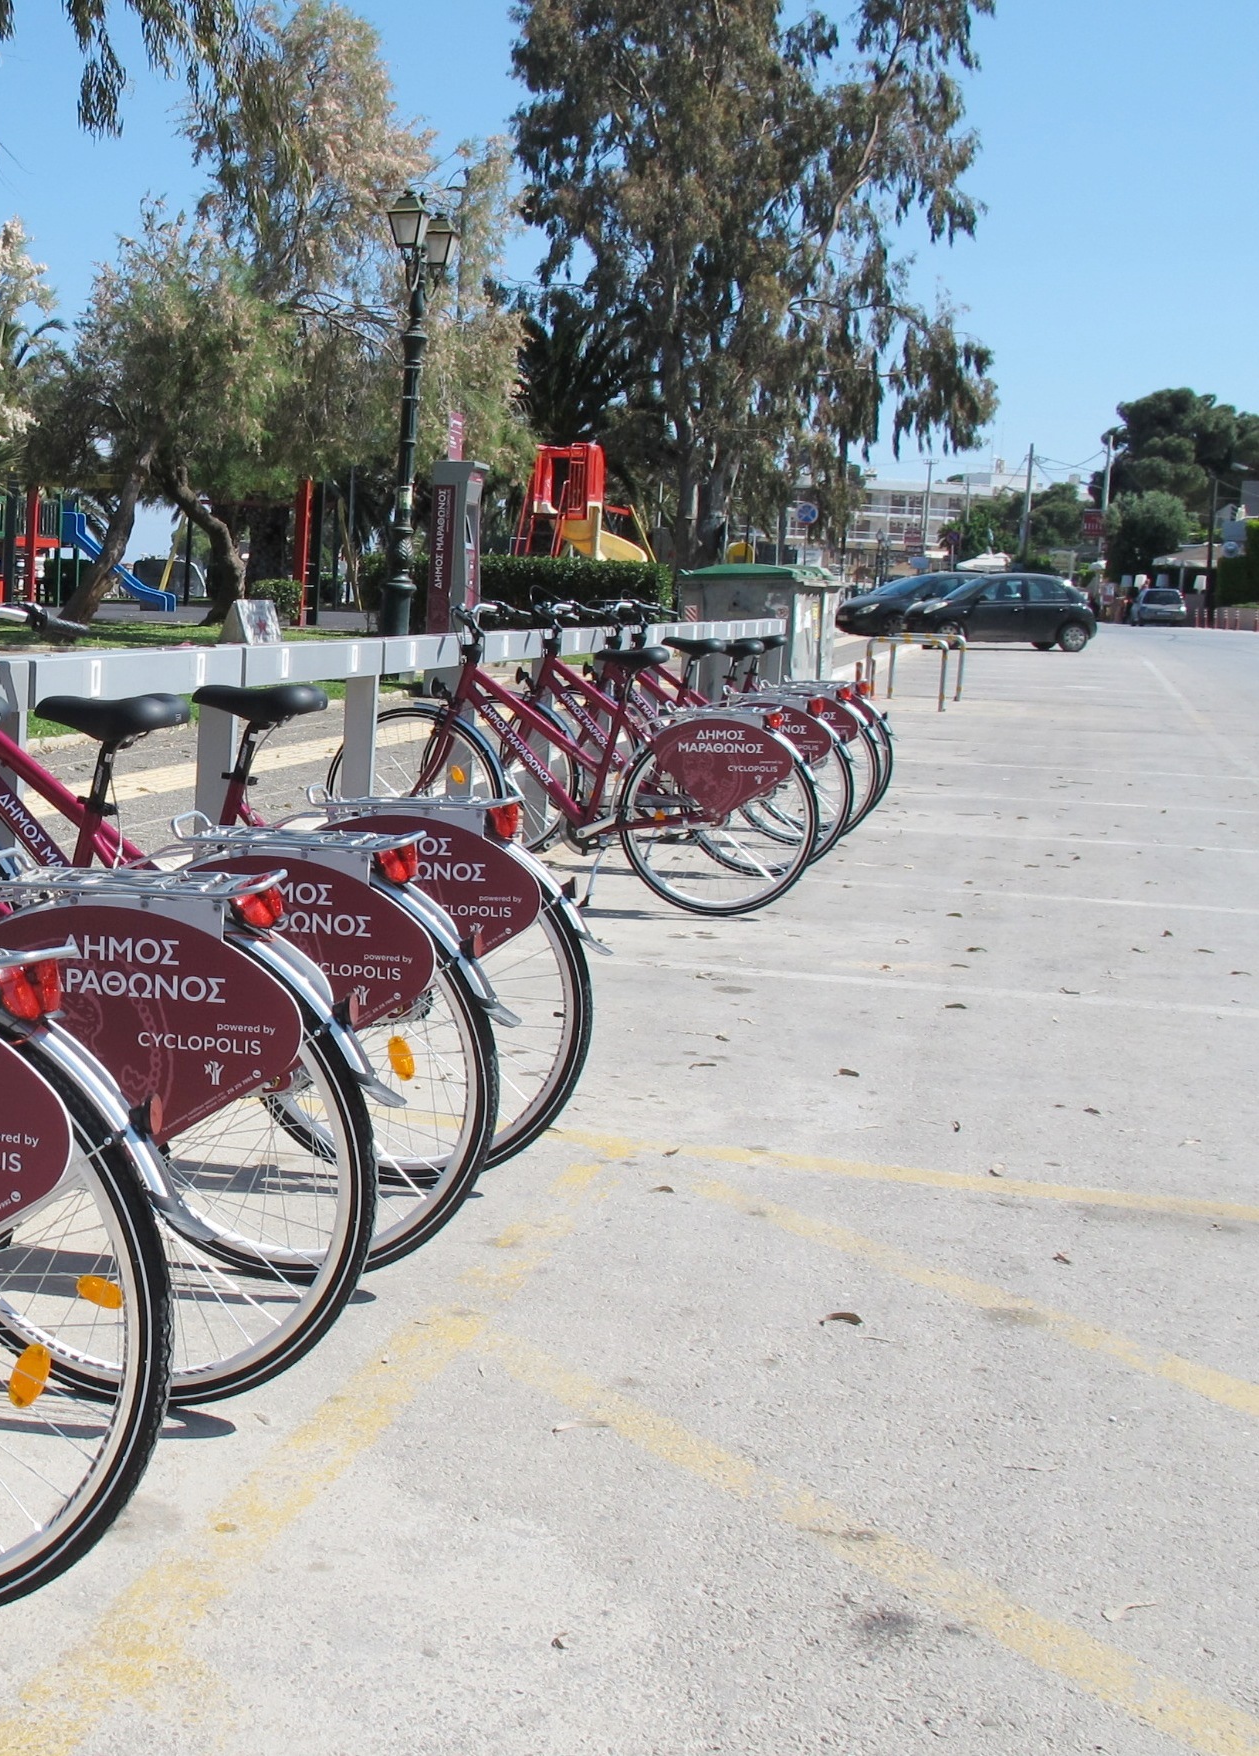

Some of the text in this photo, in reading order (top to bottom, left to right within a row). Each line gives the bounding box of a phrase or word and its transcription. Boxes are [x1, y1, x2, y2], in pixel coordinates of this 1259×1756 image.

[696, 729, 745, 741] ΔΗΜΟΣ
[480, 703, 554, 786] ΔΗΜΟΣ ΜΑΡΑΘΩΝΟΣ
[678, 742, 764, 754] ΜΑΡΑΘΩΝΟΣ
[275, 882, 332, 906] ΜΟΣ
[363, 953, 413, 964] powered by
[316, 962, 401, 981] CLOPOLIS
[216, 1023, 276, 1035] powered by
[137, 1031, 262, 1055] CYCLOPOLIS
[24, 1133, 40, 1147] by
